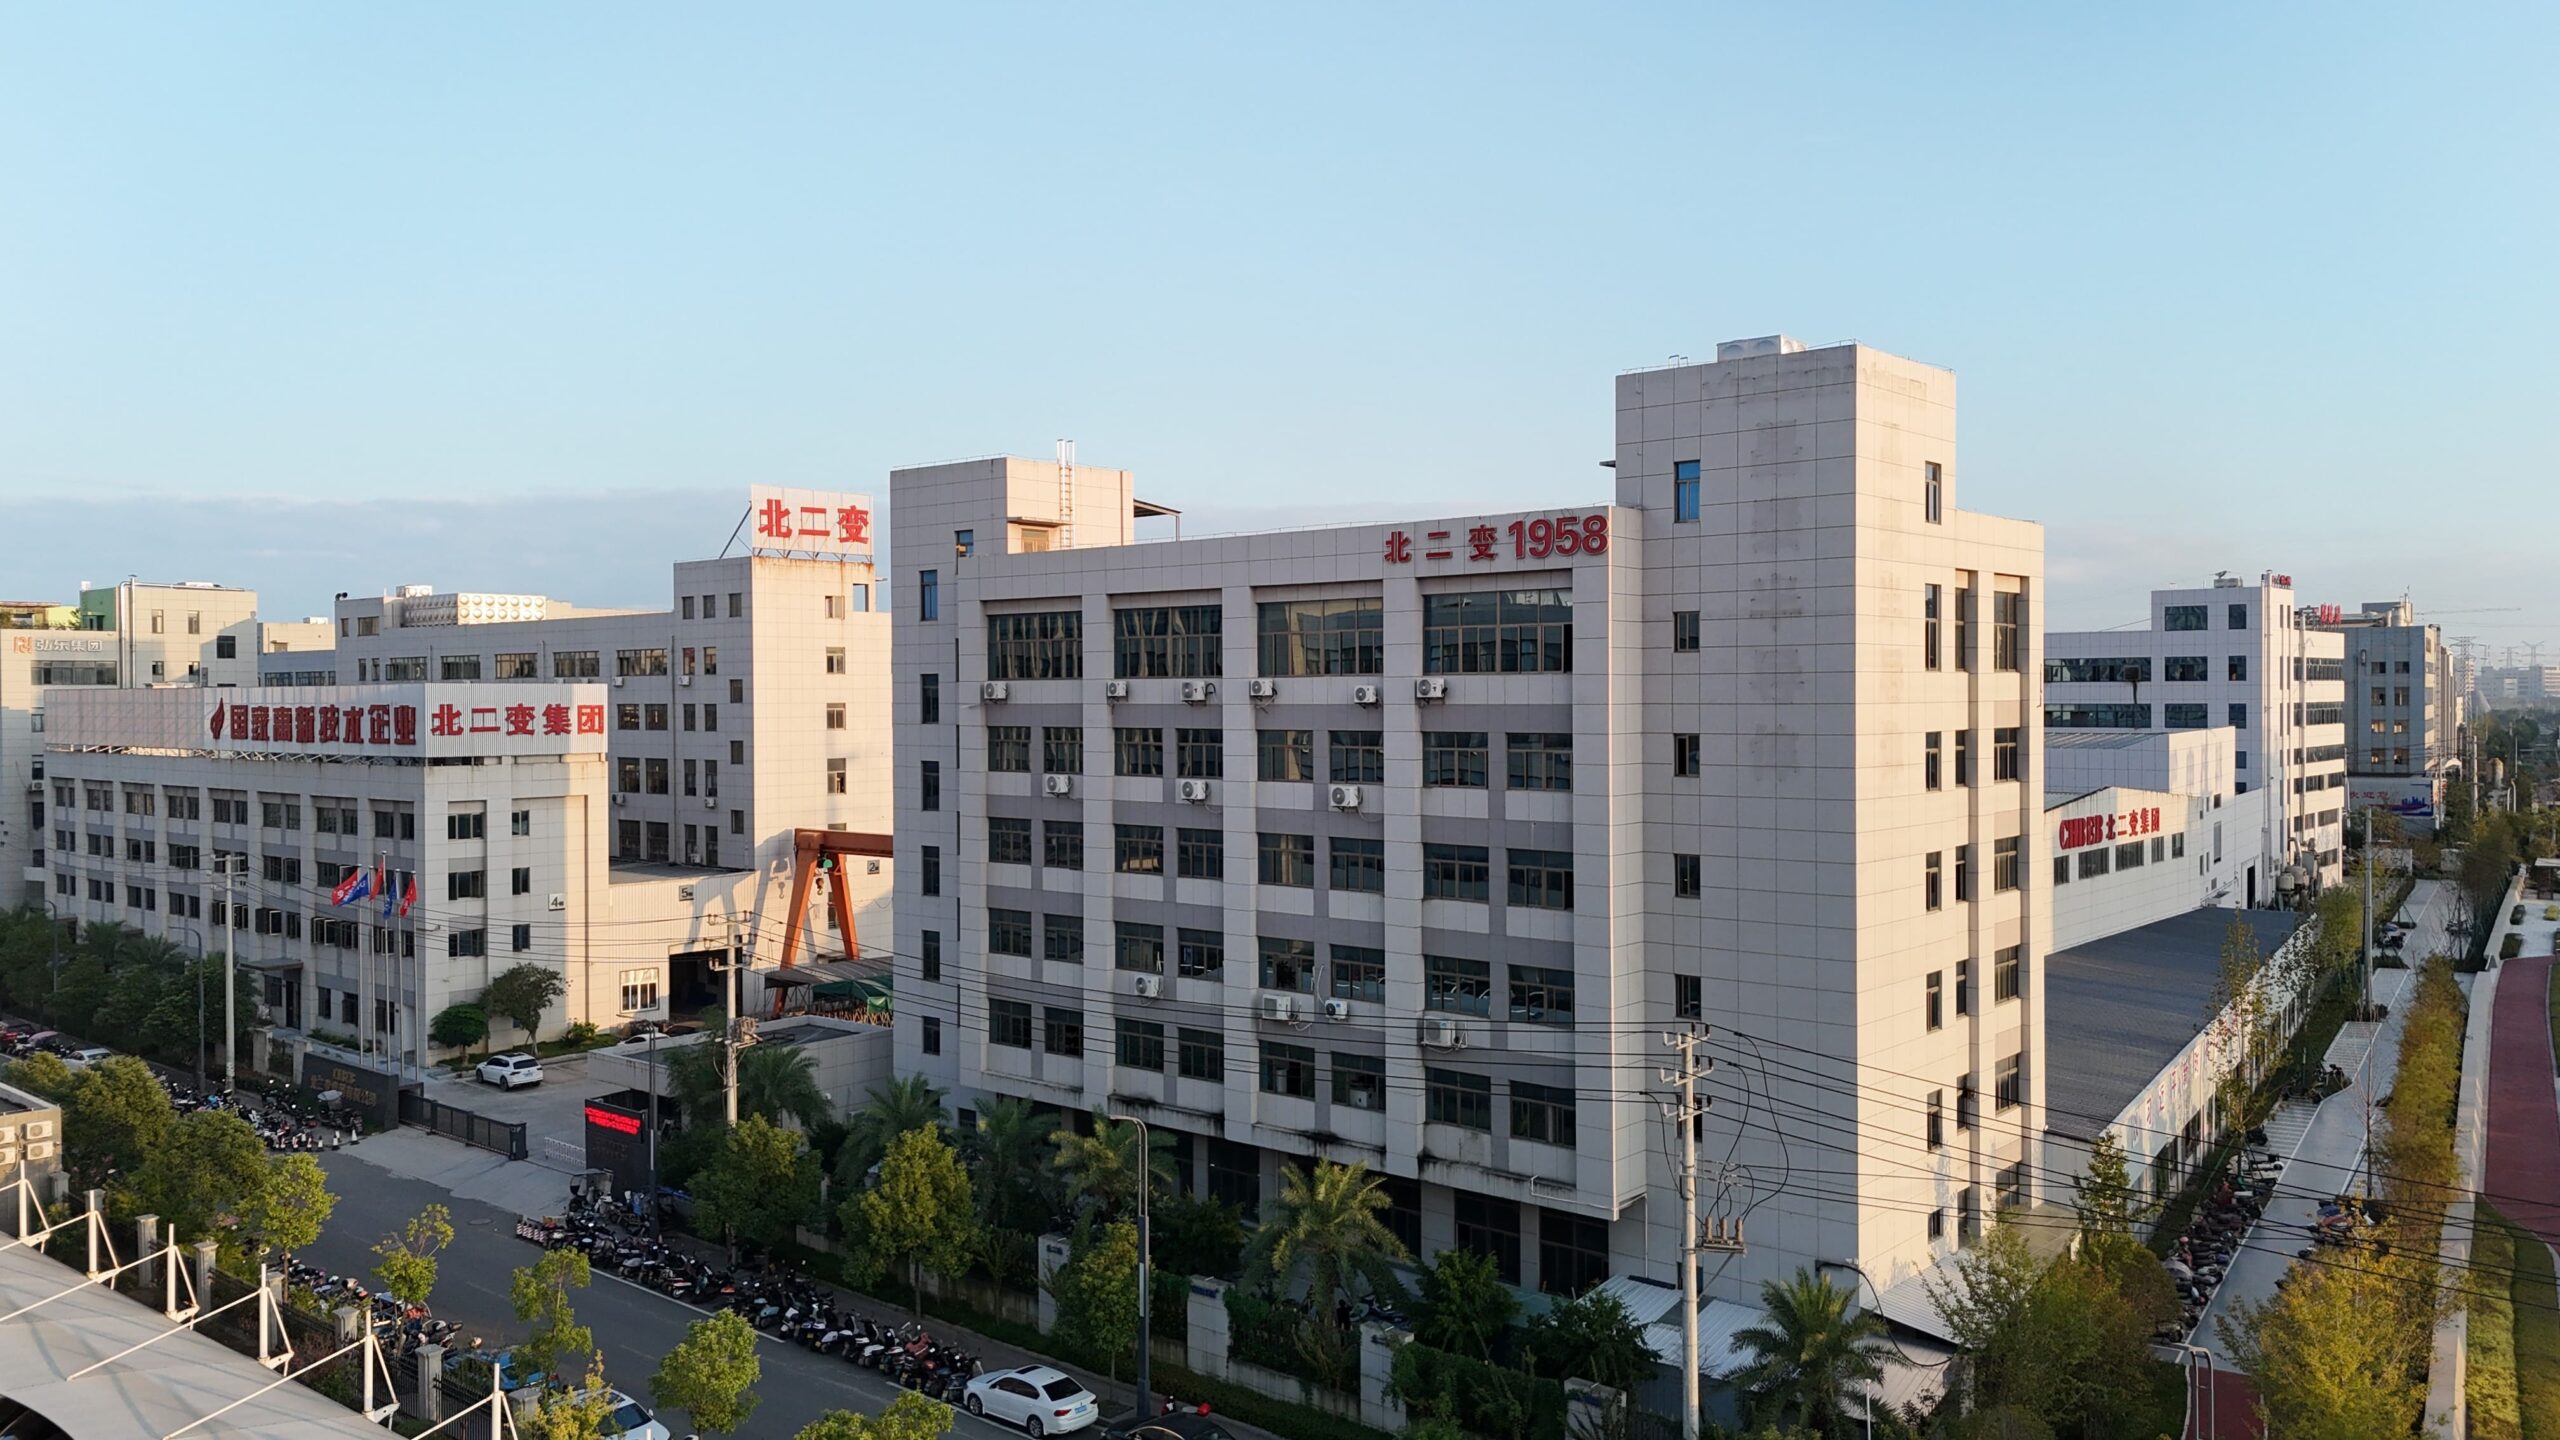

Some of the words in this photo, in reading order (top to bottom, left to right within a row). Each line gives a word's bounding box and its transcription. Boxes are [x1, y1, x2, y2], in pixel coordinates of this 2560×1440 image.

[758, 498, 869, 544] 北二变
[36, 639, 102, 652] 弘乐集团
[231, 704, 416, 745] 国家高新技术企业
[431, 703, 604, 736] 北二变集团
[2106, 807, 2160, 840] 北二变集团
